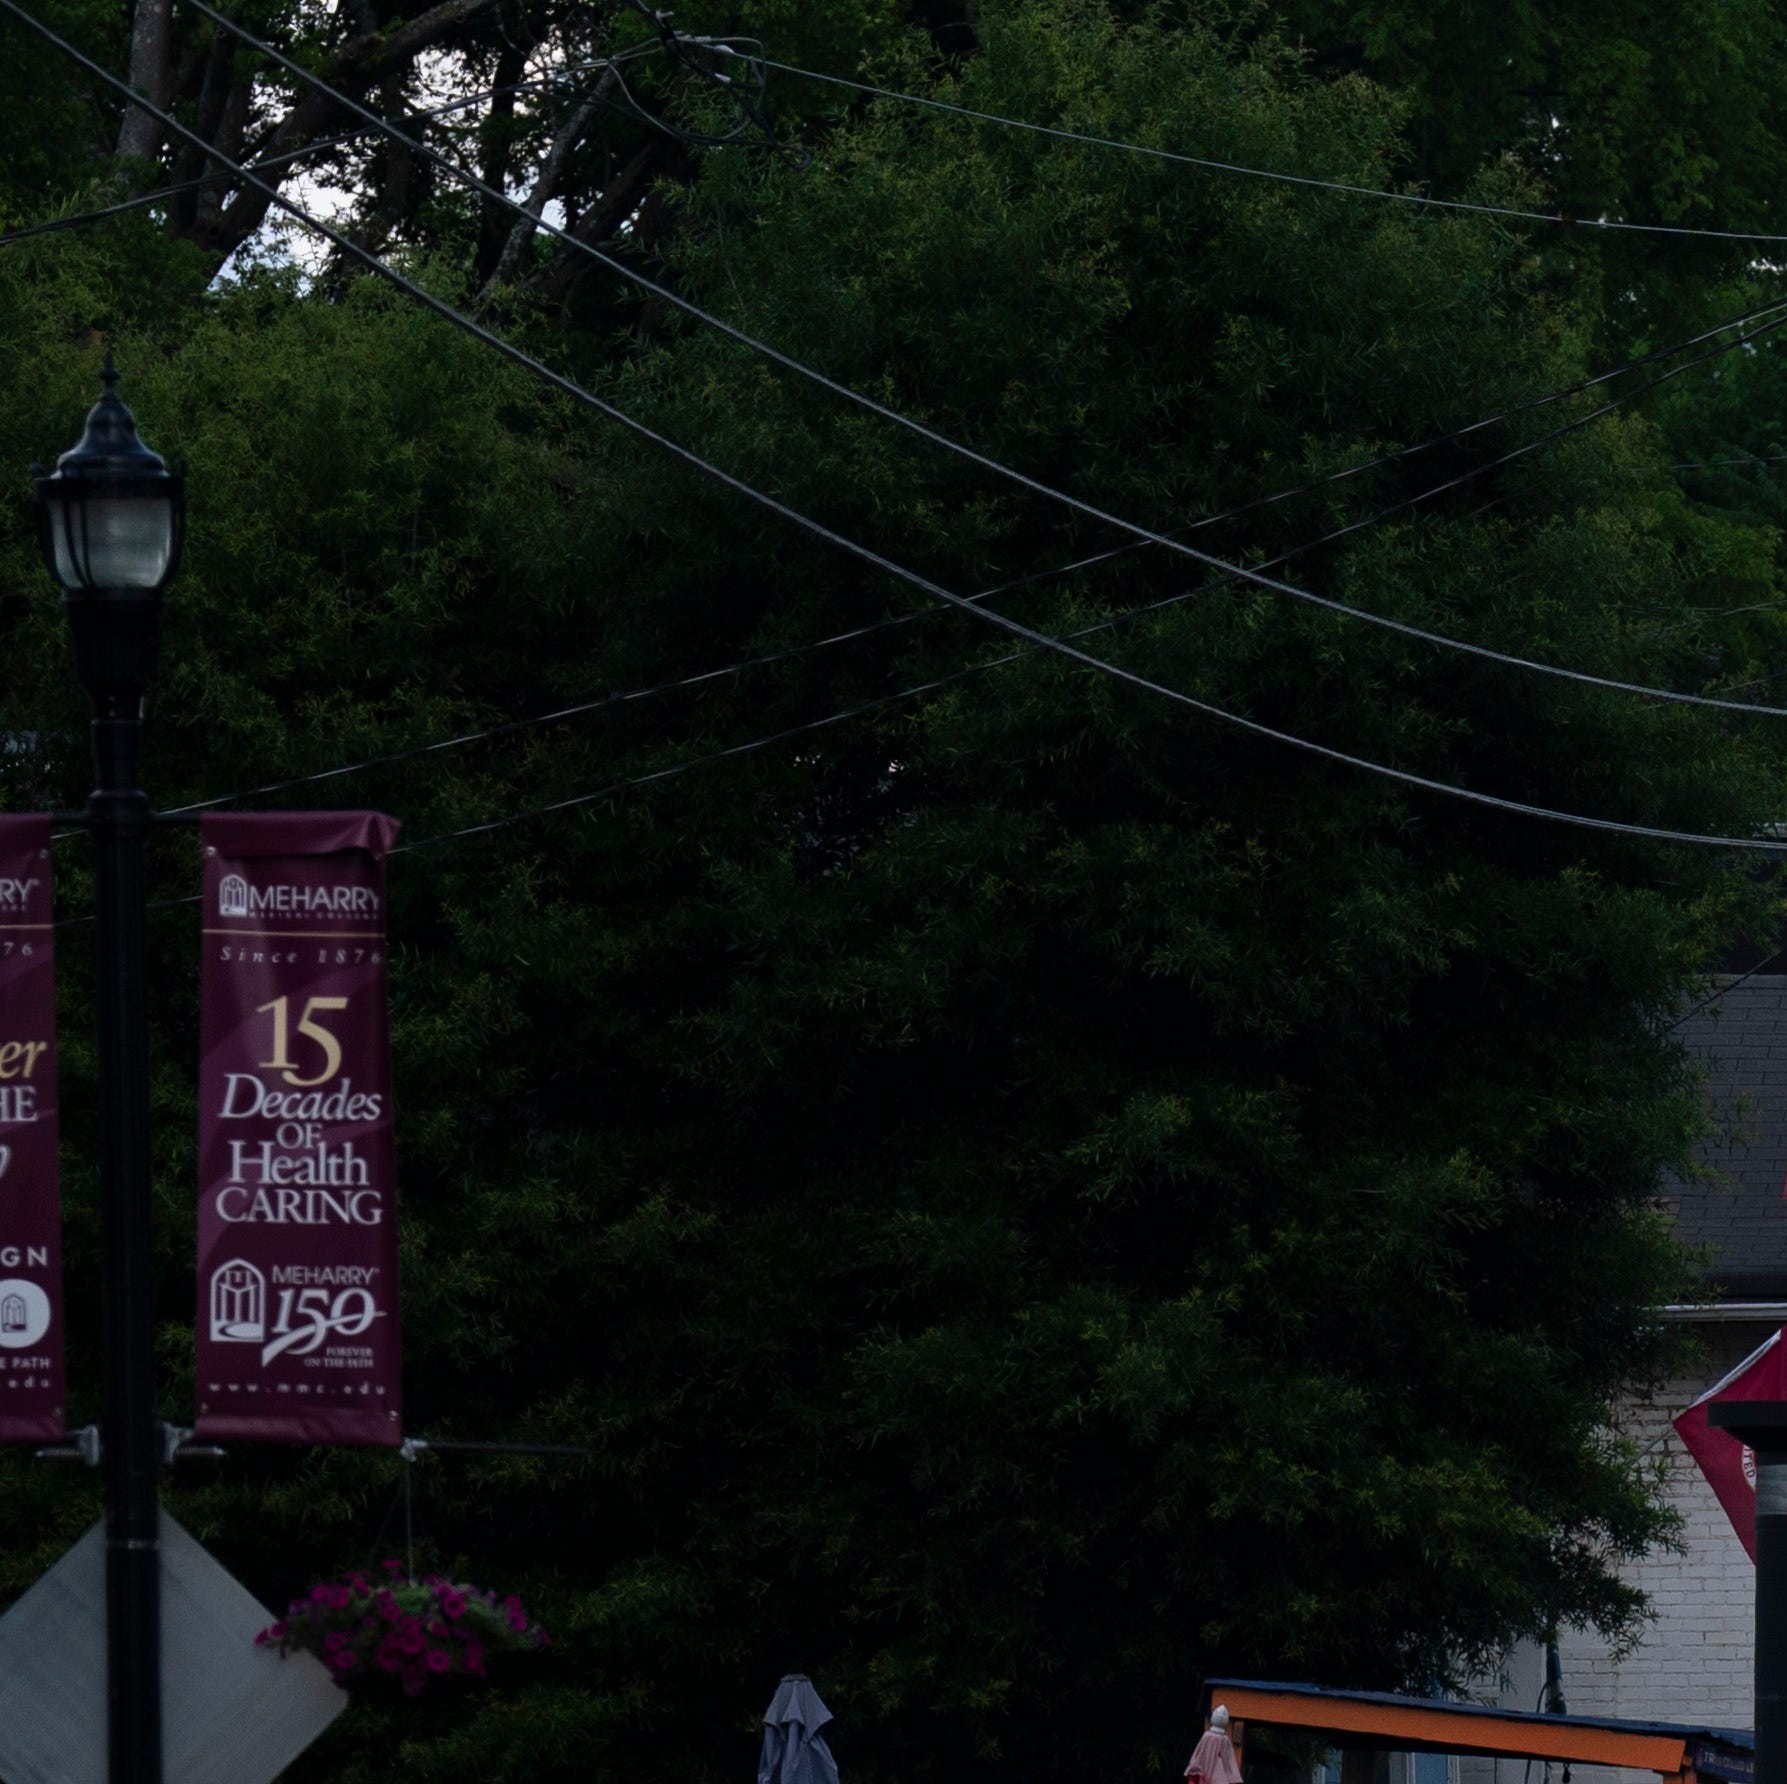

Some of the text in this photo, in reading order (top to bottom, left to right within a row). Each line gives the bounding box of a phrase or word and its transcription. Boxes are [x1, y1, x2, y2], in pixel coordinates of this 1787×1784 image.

[250, 885, 380, 911] MEHARRY
[220, 945, 382, 964] Since 1876
[255, 994, 349, 1087] 15
[218, 1072, 383, 1121] Decades
[275, 1121, 323, 1150] OF
[227, 1139, 369, 1187] Health
[215, 1186, 384, 1226] CARING
[272, 1265, 375, 1285] MEHARRY
[269, 1287, 380, 1359] 150
